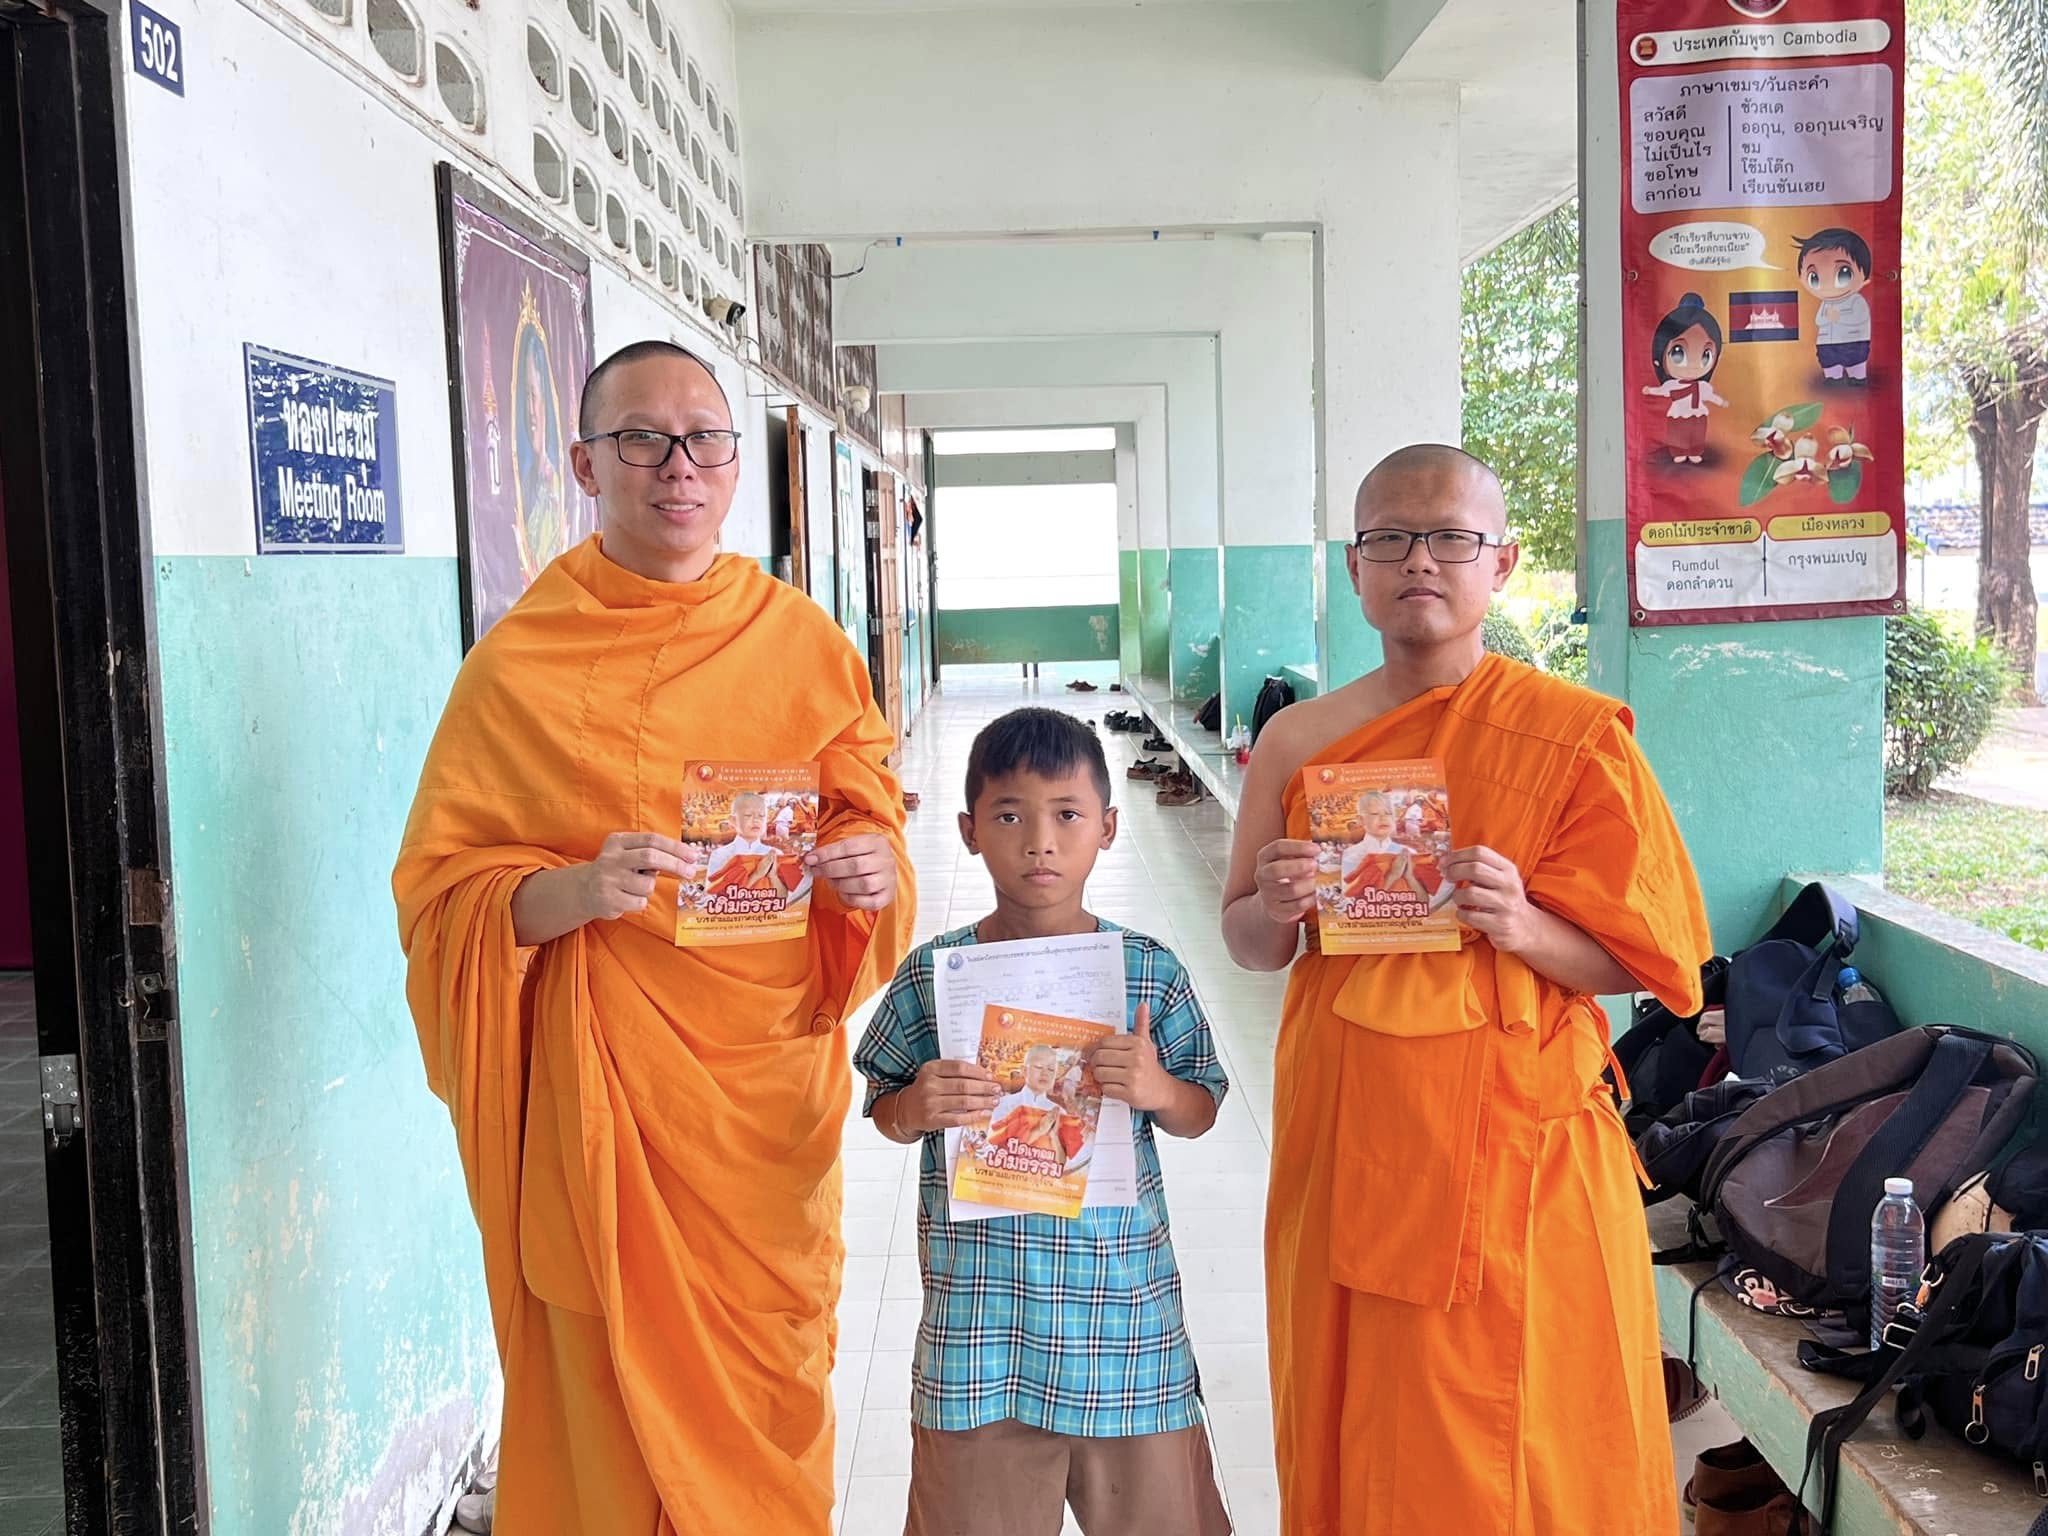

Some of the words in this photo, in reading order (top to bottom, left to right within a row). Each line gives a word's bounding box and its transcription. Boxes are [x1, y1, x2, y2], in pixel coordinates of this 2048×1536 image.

[141, 15, 178, 83] 502
[1673, 29, 1775, 52] ประเทศกัมพูชา
[1783, 28, 1858, 46] Cambodia
[1680, 75, 1829, 97] ภาษาเขมร/วันละคำ
[1644, 104, 1687, 122] สวัสดี
[1644, 125, 1705, 143] ขอบคุณ
[1794, 115, 1884, 137] ออกุนเจริญ
[1644, 142, 1712, 163] ไม่เป็นไร
[1645, 165, 1698, 182] ขอโทษ
[1645, 183, 1702, 202] ลาก่อน
[278, 466, 342, 531] Meeting
[345, 474, 386, 523] Room
[1648, 521, 1752, 539] ดอกไม้ประจำชาติ
[1801, 516, 1865, 533] เมืองหลวง
[1672, 559, 1720, 573] Rumdul
[1788, 551, 1867, 570] กรุงพนมเปญ
[1666, 576, 1734, 592] ดอกลำดวน
